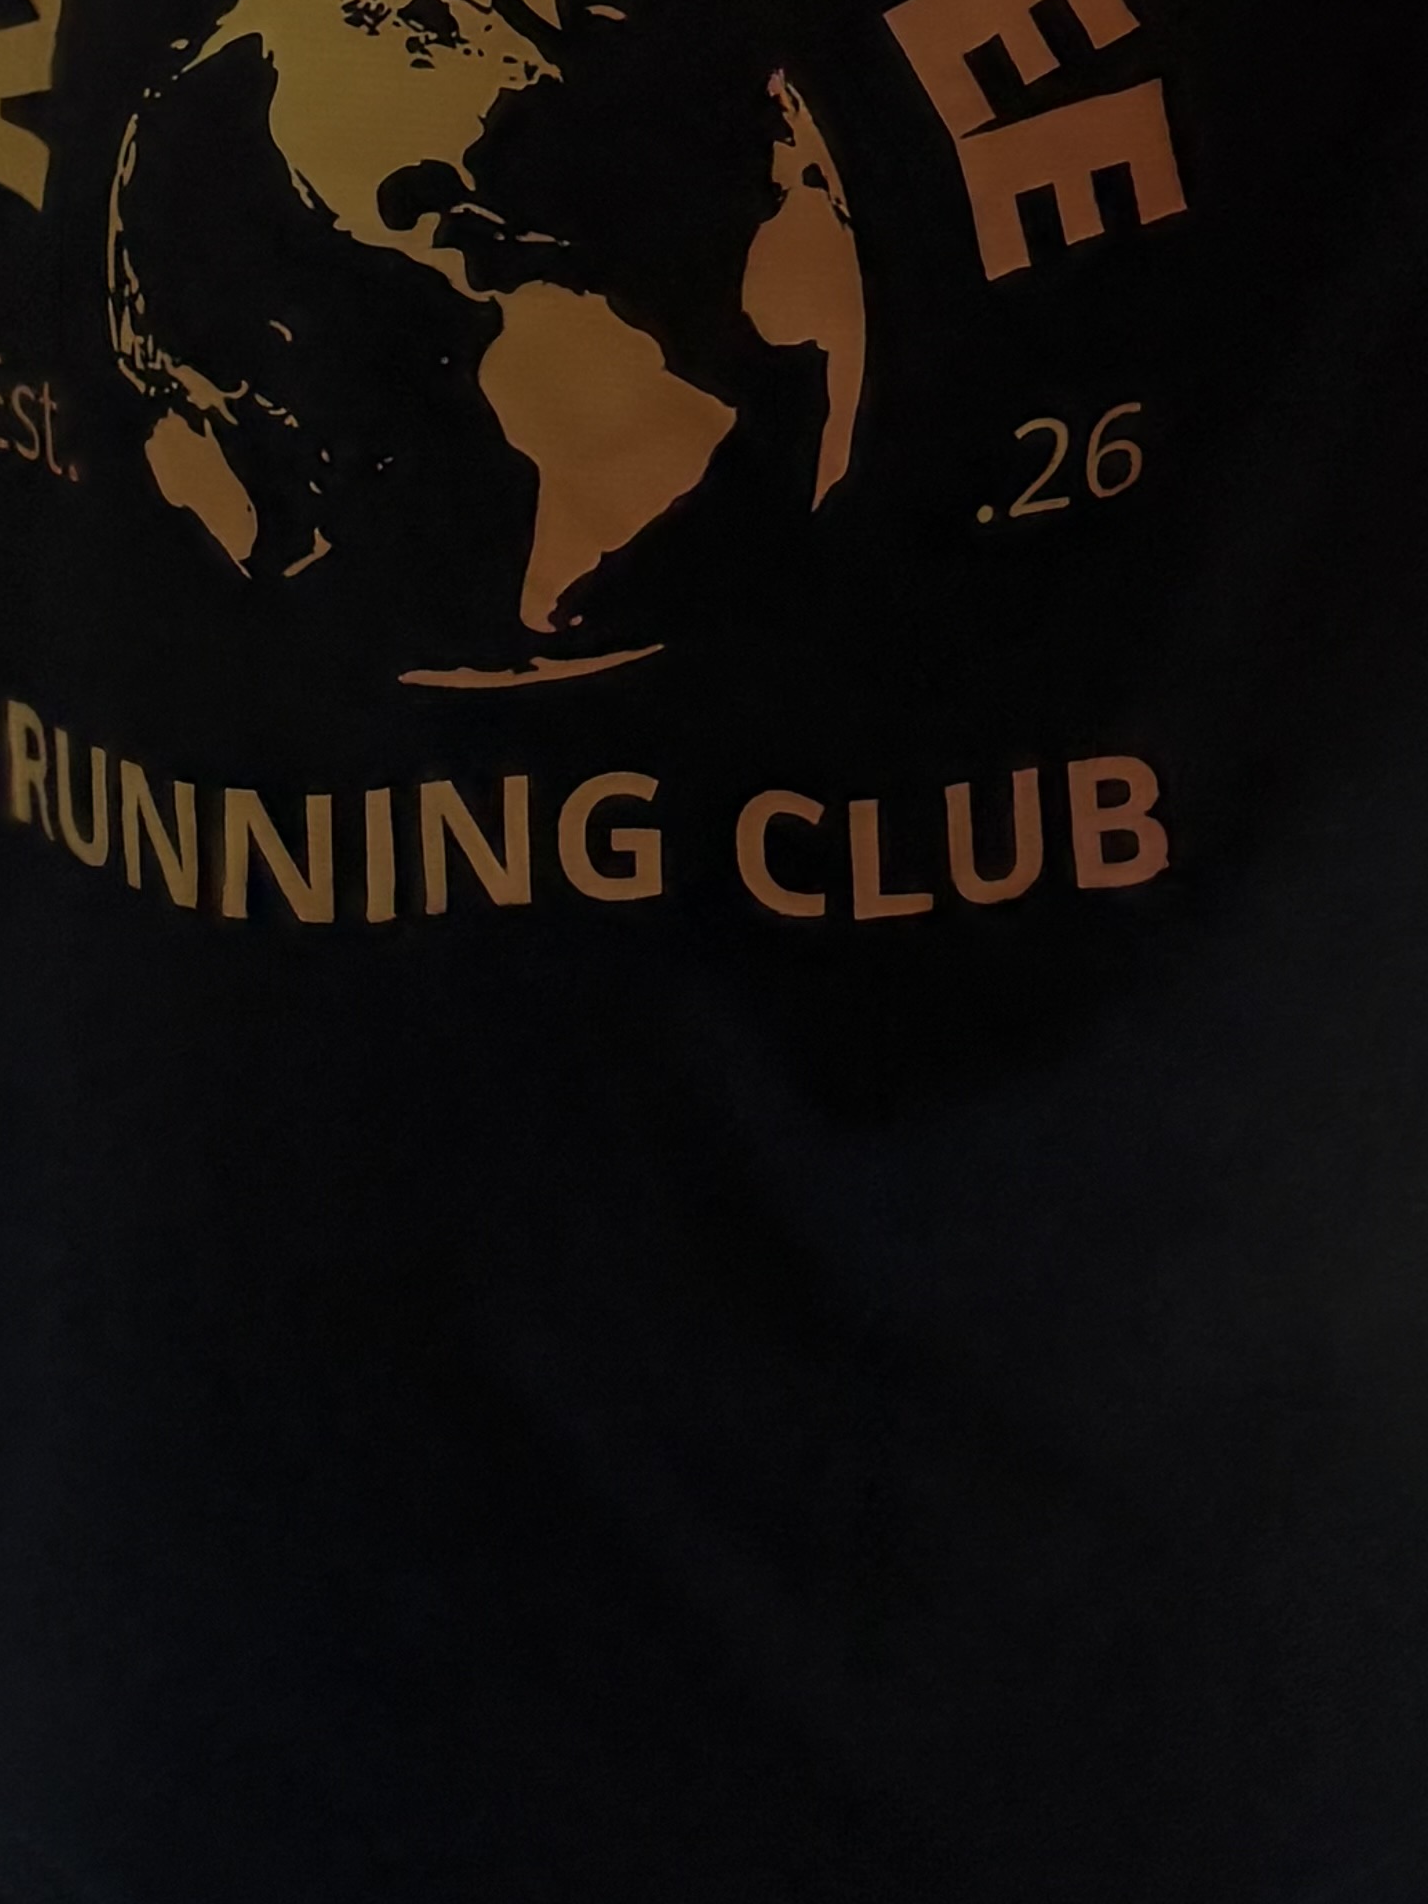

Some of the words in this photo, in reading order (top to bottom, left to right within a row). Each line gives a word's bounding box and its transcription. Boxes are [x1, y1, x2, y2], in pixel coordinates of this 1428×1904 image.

[975, 402, 1144, 524] .26
[4, 700, 664, 924] RUNNING
[735, 754, 1170, 920] CLUB
